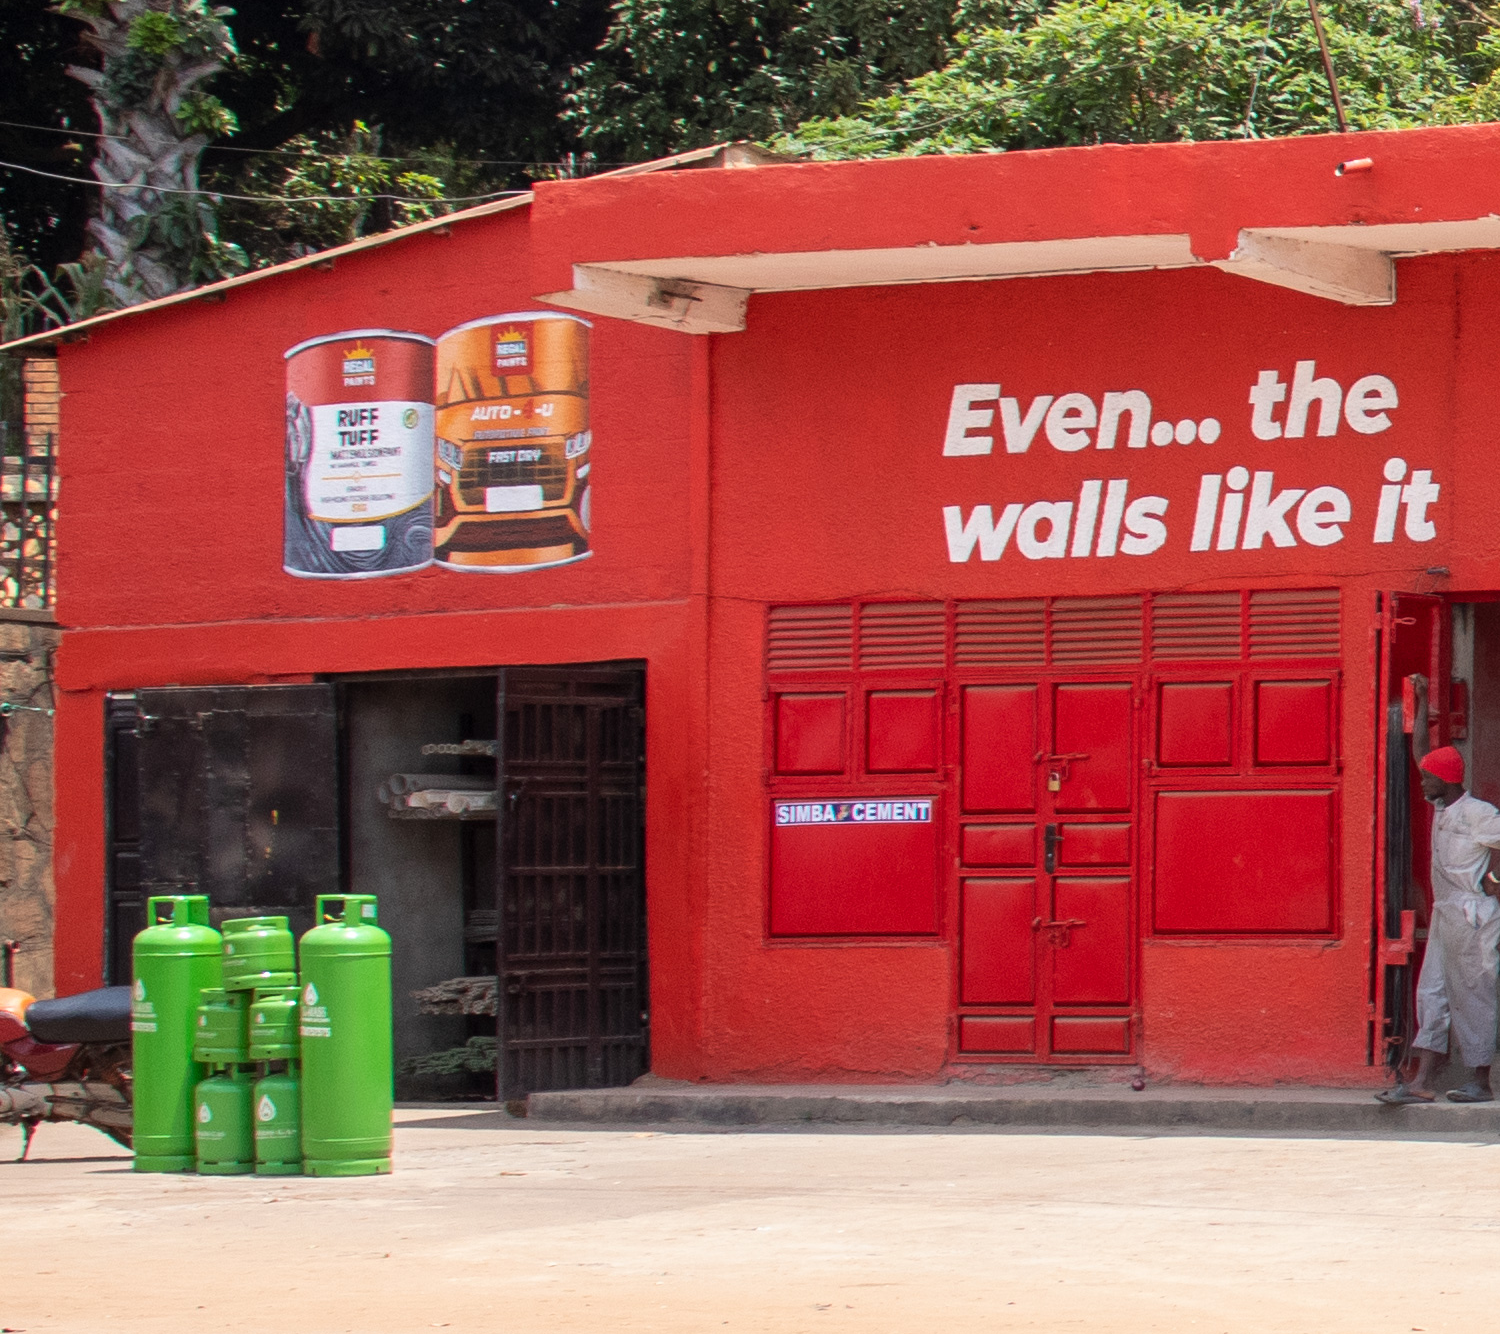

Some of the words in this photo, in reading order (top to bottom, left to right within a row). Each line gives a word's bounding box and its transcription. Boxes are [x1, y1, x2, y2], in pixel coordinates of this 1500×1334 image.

[343, 359, 374, 375] REGAL
[338, 408, 379, 427] RUFF
[942, 382, 1221, 457] Even...
[1248, 360, 1399, 441] the
[337, 429, 379, 446] TUFF
[942, 478, 1169, 563] walls
[1190, 465, 1351, 552] like
[1373, 457, 1441, 543] it
[778, 804, 836, 823] SIMBA
[852, 803, 930, 821] CEMENT
